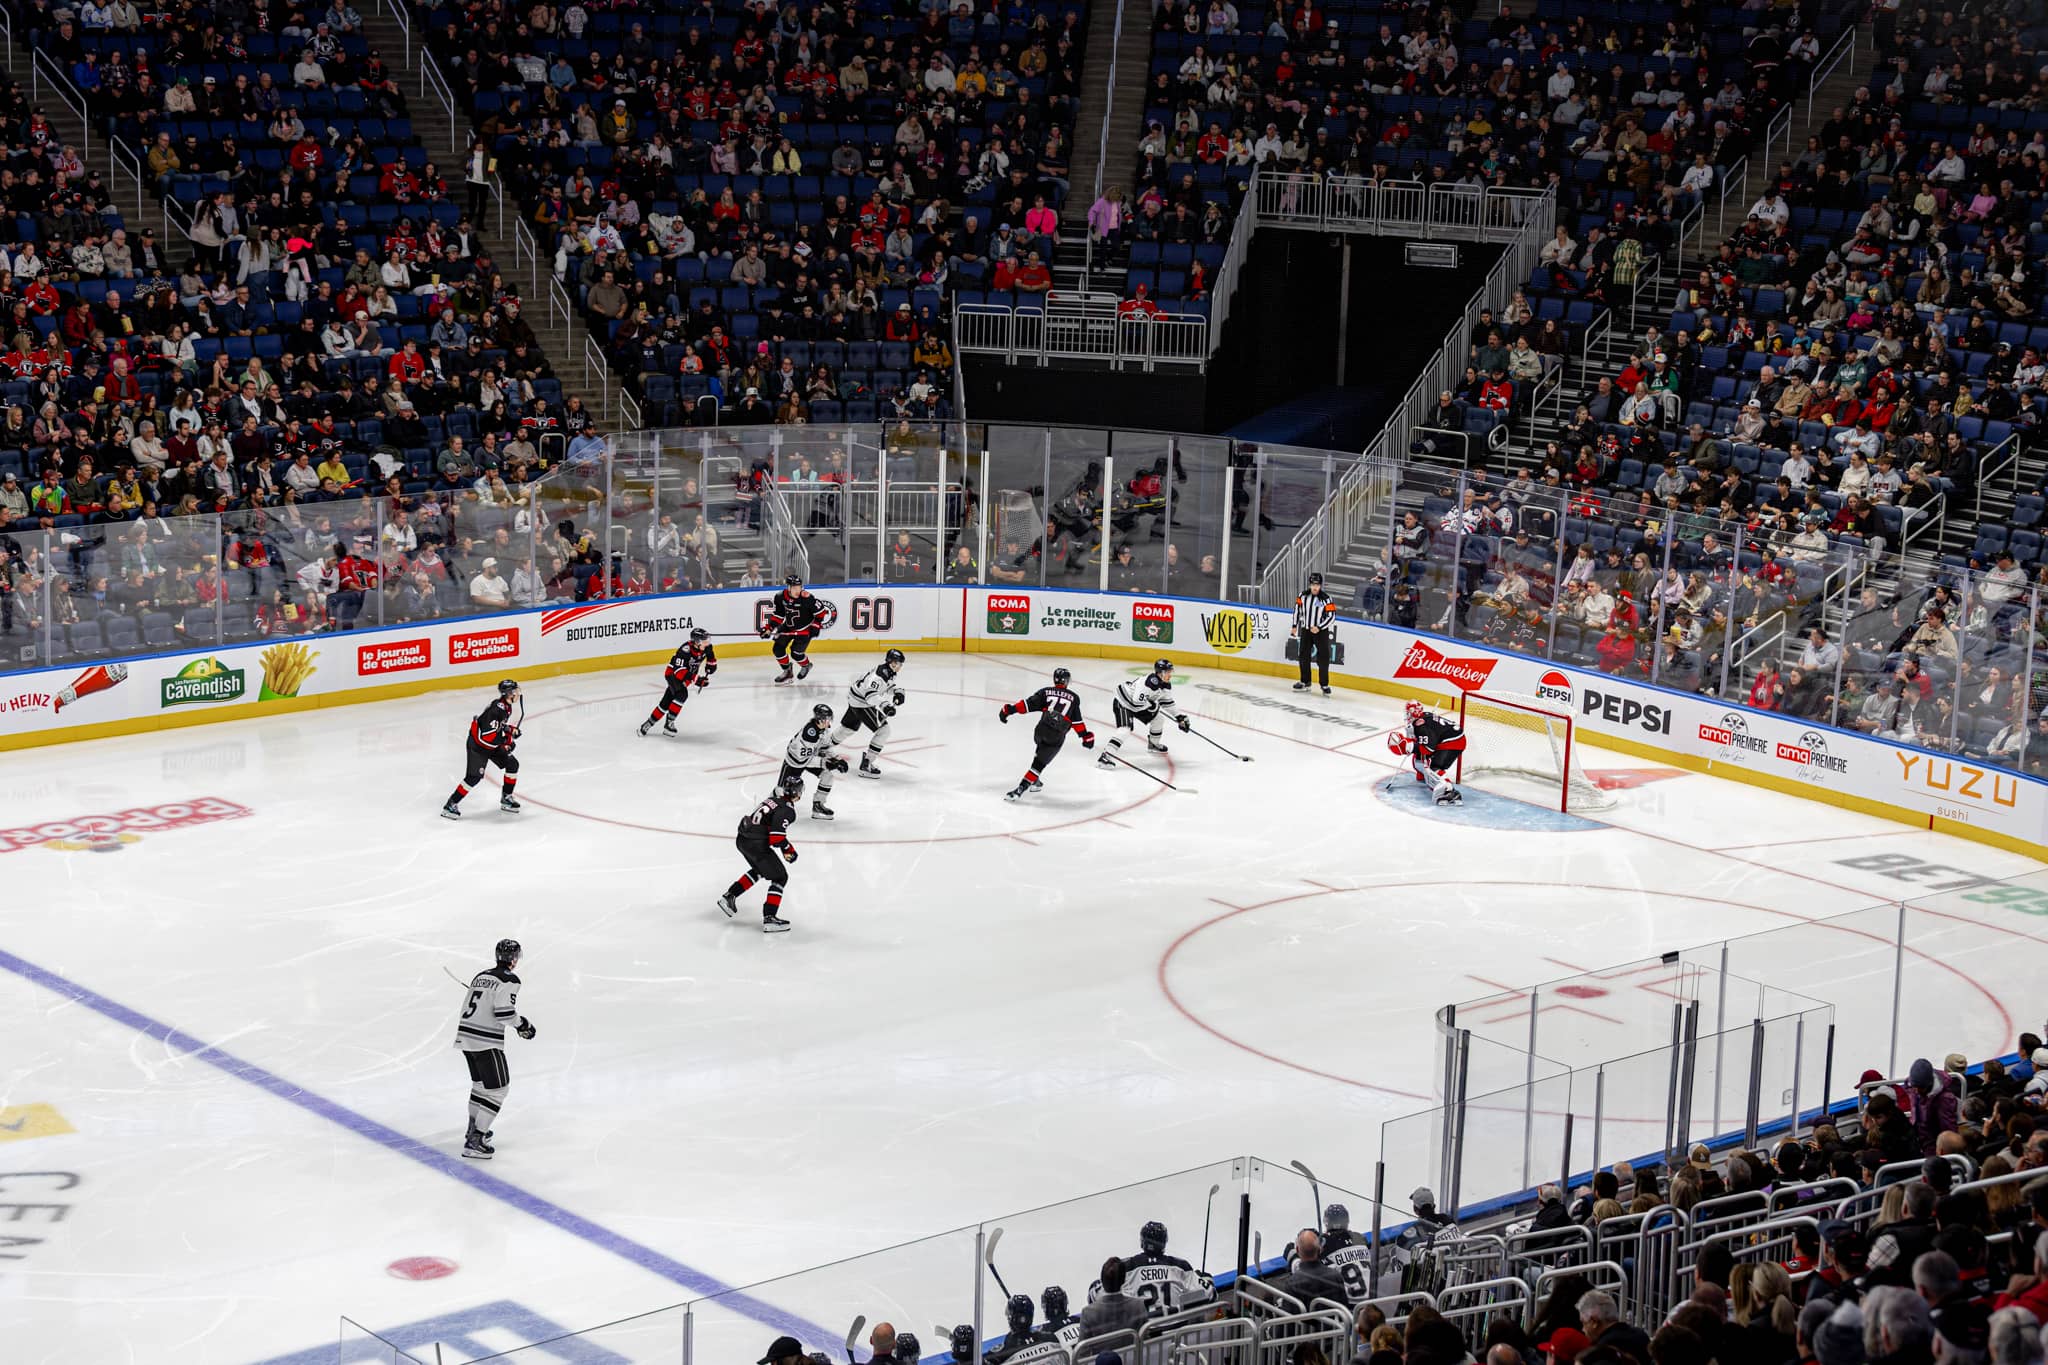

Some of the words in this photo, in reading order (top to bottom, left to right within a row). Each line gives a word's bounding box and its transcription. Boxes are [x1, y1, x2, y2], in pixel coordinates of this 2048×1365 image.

[990, 597, 1028, 609] ROMA
[850, 596, 894, 632] GO
[1047, 606, 1062, 617] Le
[1064, 607, 1117, 620] meilleur
[1135, 606, 1172, 618] ROMA
[566, 616, 694, 641] BOUTIQUE.REMPARTS.CA
[1041, 617, 1055, 628] ça
[1057, 618, 1071, 627] se
[1073, 617, 1122, 631] partage
[454, 640, 465, 650] le
[467, 634, 509, 650] journal
[1250, 632, 1270, 640] FM
[362, 651, 374, 661] le
[376, 645, 420, 661] journal
[453, 649, 469, 659] de
[362, 660, 378, 670] de
[675, 657, 684, 667] 91
[1403, 648, 1489, 683] Budweiser
[166, 675, 240, 700] Cavendish
[870, 681, 880, 690] 61
[9, 693, 50, 711] HEINZ
[1540, 686, 1571, 703] PEPSI
[1046, 696, 1072, 716] 77
[1194, 683, 1380, 733] consignaction
[1583, 688, 1672, 735] PEPSI
[1417, 735, 1429, 745] 33
[1700, 726, 1731, 746] amq
[1732, 732, 1768, 754] PREMIERE
[800, 747, 813, 757] 22
[1778, 745, 1809, 765] amq
[1810, 751, 1848, 774] PREMIERE
[1896, 751, 2018, 808] YUZU
[1936, 806, 1969, 822] sushi
[462, 990, 483, 1019] 5
[510, 993, 517, 1005] 5
[1140, 1268, 1169, 1281] SEROV
